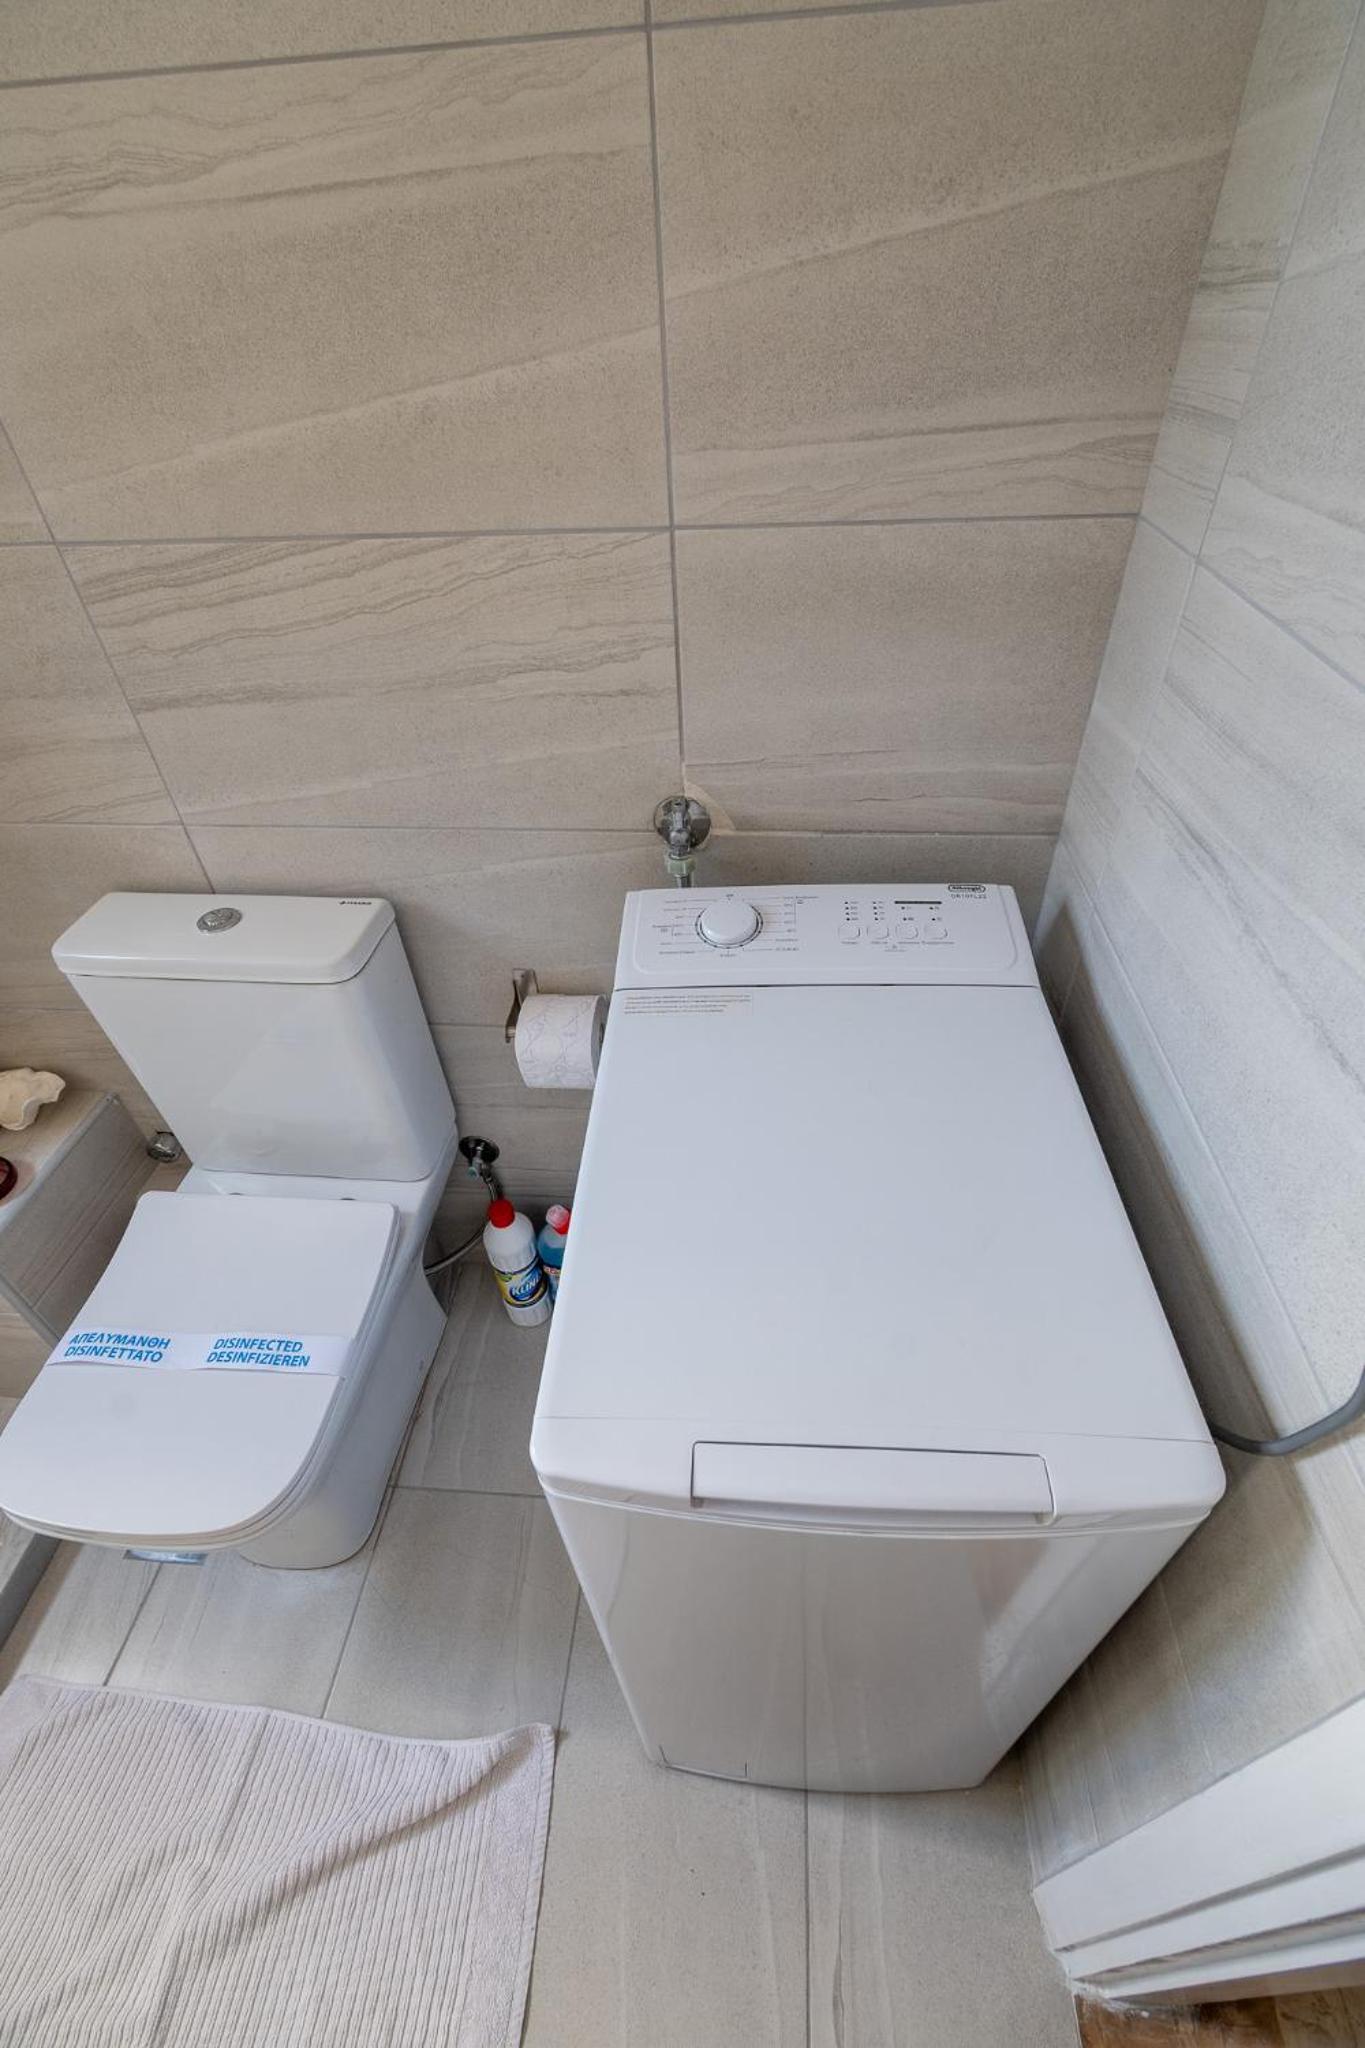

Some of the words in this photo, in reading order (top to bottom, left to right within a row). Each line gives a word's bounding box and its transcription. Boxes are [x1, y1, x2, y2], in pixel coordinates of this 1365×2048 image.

[69, 1332, 171, 1350] ΑΠΕΛΥΜΑΝΘΗ
[213, 1338, 303, 1352] DISINFECTED
[64, 1346, 163, 1363] DISINFETTATO
[206, 1352, 311, 1367] DESINFIZIEREN
